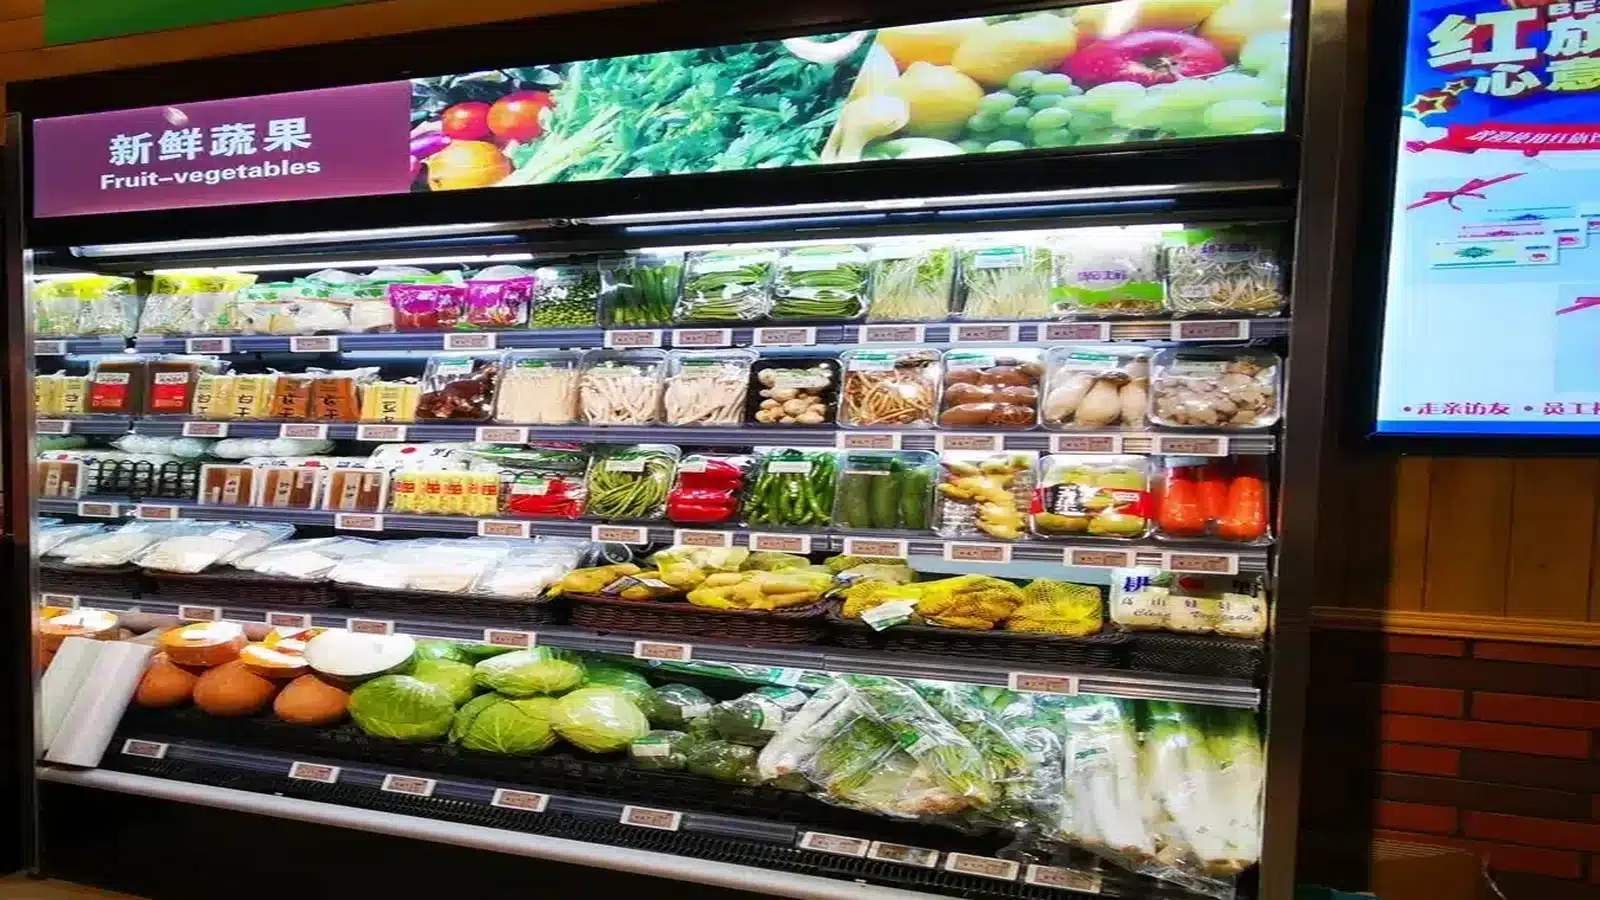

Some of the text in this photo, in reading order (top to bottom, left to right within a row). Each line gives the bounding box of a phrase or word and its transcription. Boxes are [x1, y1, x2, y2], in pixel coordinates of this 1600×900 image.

[109, 116, 313, 166] 新鲜蔬果
[1417, 402, 1511, 416] 走亲访友
